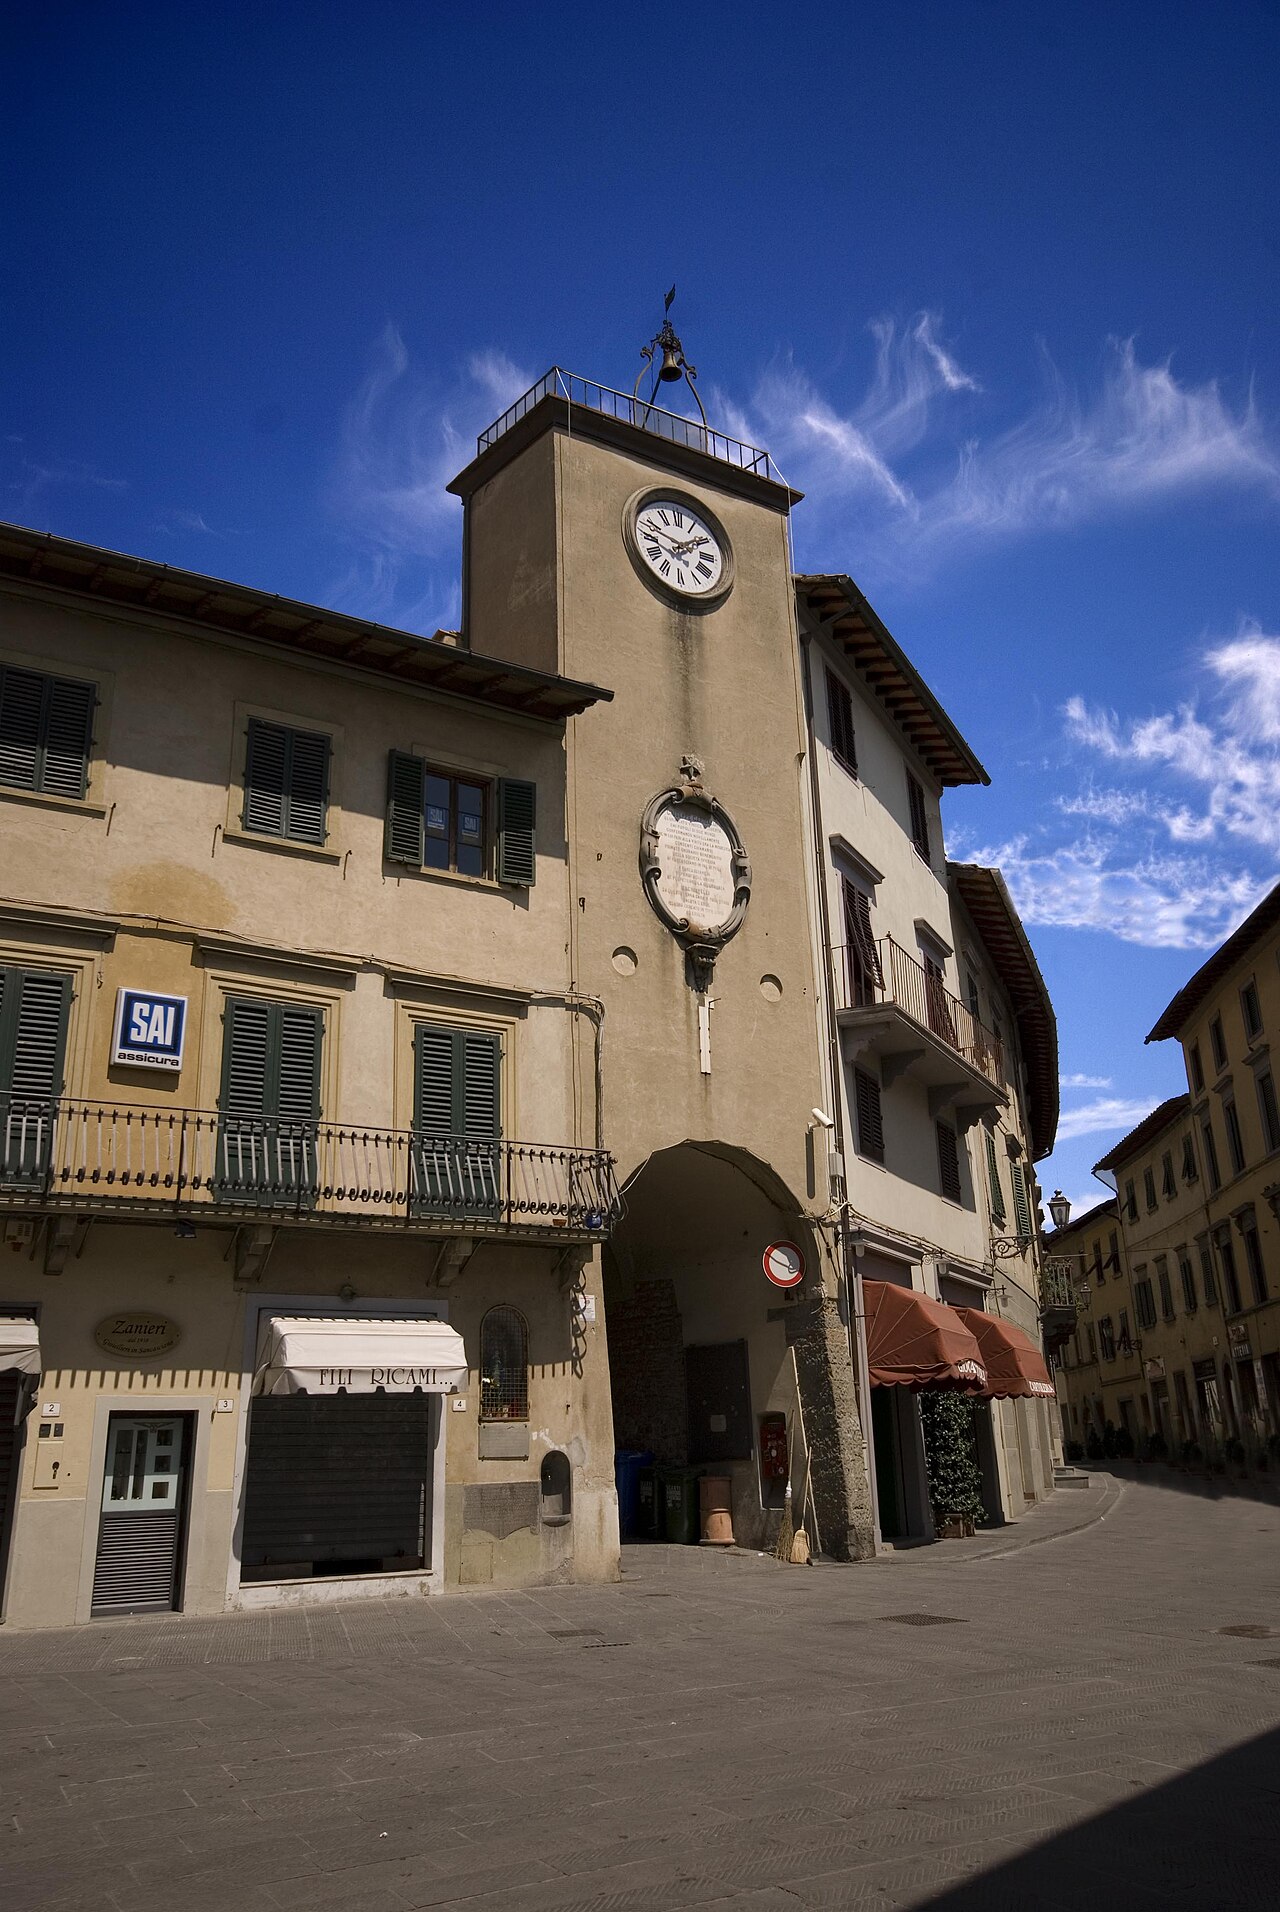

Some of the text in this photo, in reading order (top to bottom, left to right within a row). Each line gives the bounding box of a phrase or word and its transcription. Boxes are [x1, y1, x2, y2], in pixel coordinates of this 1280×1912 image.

[430, 807, 443, 823] SAI
[464, 816, 477, 831] SAI
[130, 1002, 175, 1046] SAI
[117, 1052, 180, 1067] assicura
[112, 1320, 168, 1335] Zanieri
[319, 1368, 354, 1386] FILI
[48, 1403, 55, 1412] 2
[223, 1400, 228, 1408] 3
